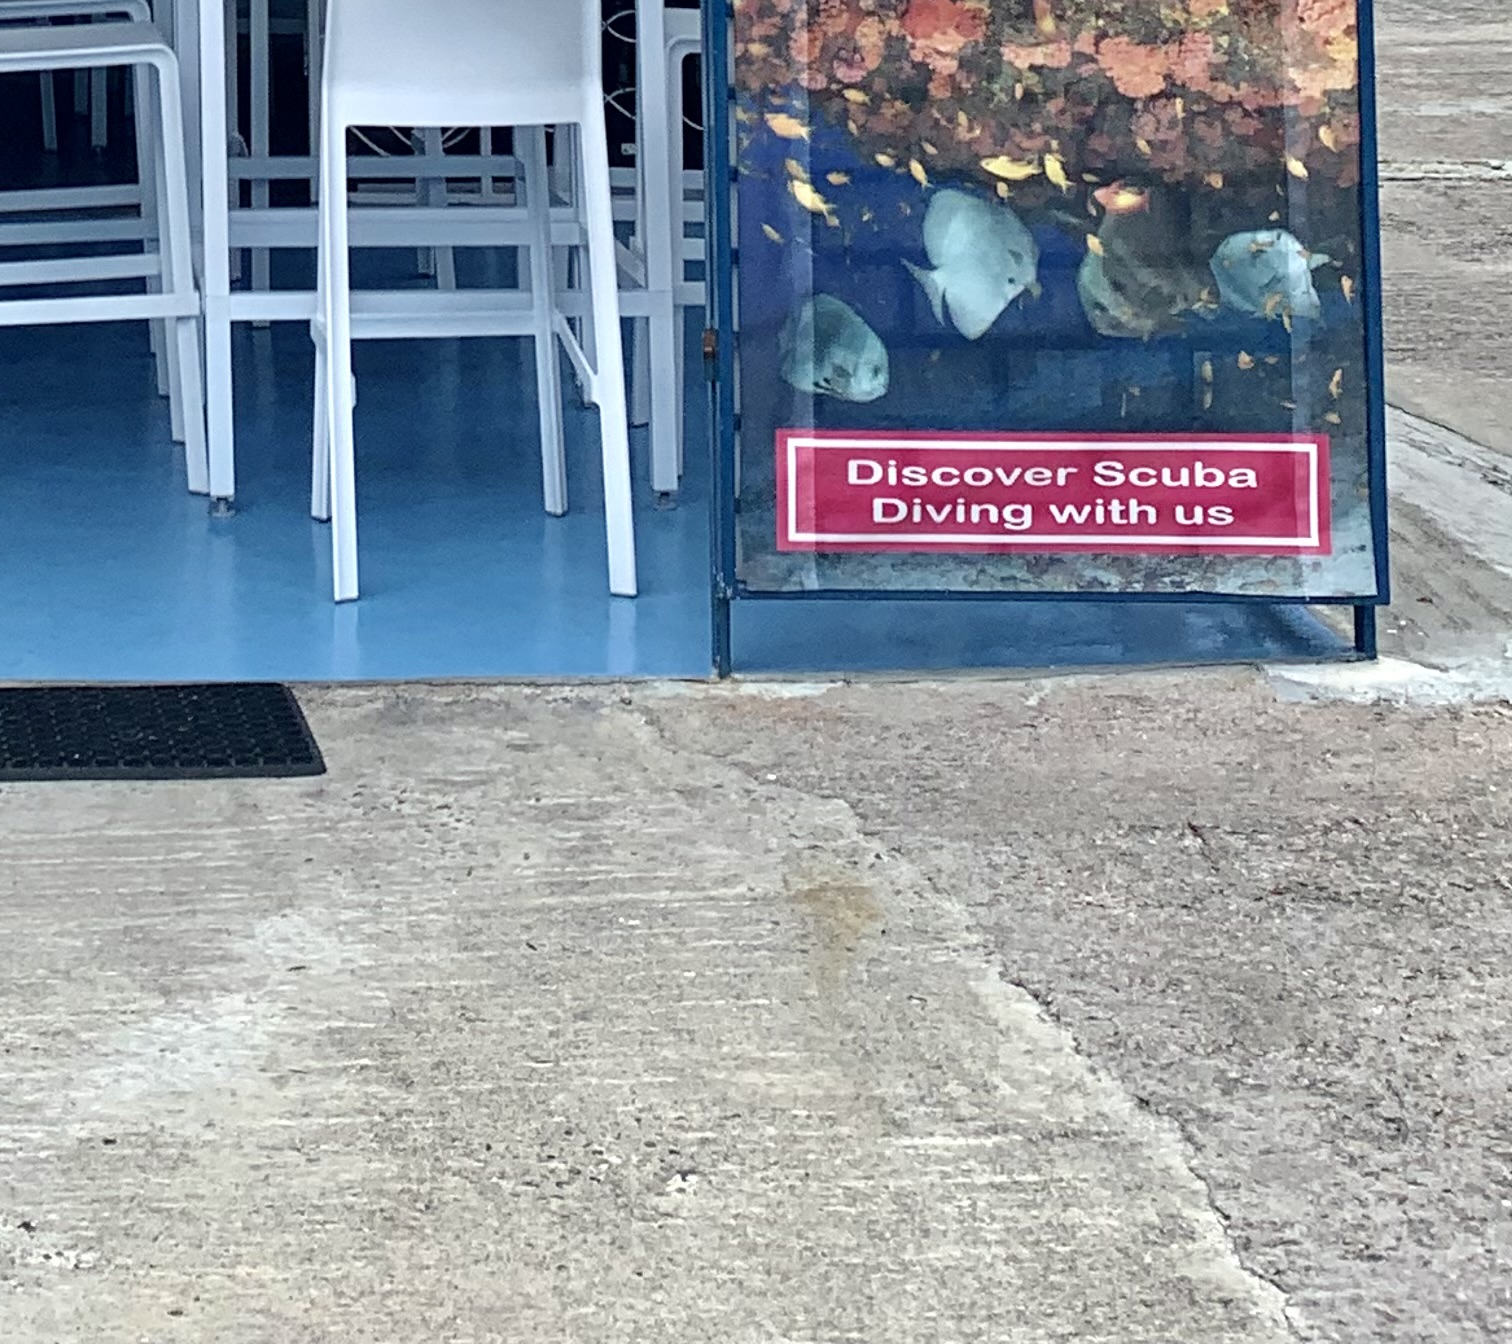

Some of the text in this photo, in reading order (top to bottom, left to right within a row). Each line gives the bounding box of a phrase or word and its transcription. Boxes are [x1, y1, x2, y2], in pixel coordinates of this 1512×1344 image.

[847, 459, 1257, 489] Discover Scuba
[873, 498, 1235, 529] Diving with us
